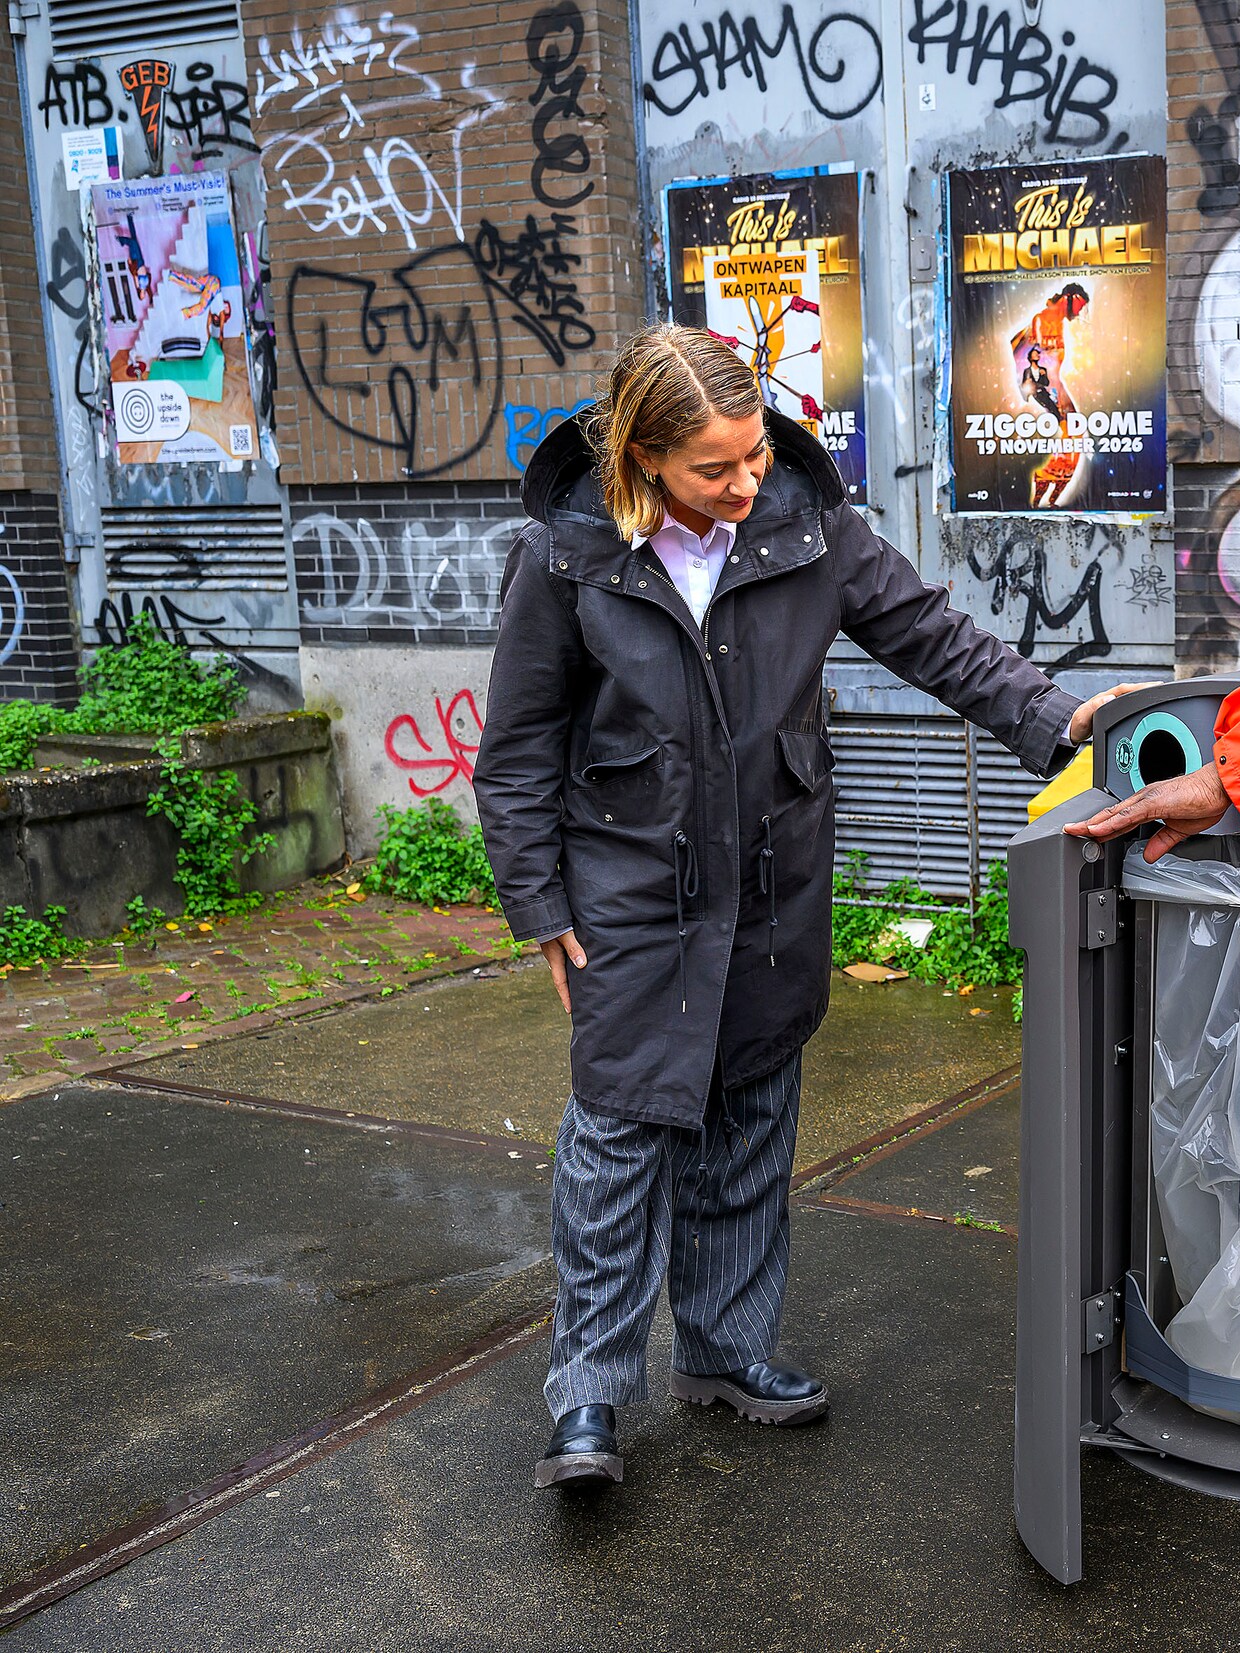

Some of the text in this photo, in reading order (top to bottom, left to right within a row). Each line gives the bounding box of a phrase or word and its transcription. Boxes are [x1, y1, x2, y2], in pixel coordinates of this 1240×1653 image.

[121, 62, 170, 91] GEB
[124, 183, 171, 198] Summer's
[1014, 185, 1069, 233] This
[964, 224, 1151, 272] MICHAEL
[716, 259, 804, 276] ONTWAPEN
[723, 282, 798, 297] KAPITAAL
[158, 403, 182, 413] upside
[160, 415, 180, 423] down
[965, 411, 1153, 439] ZIGGO DOME
[977, 437, 1143, 455] 19 NOVEMBER 2026
